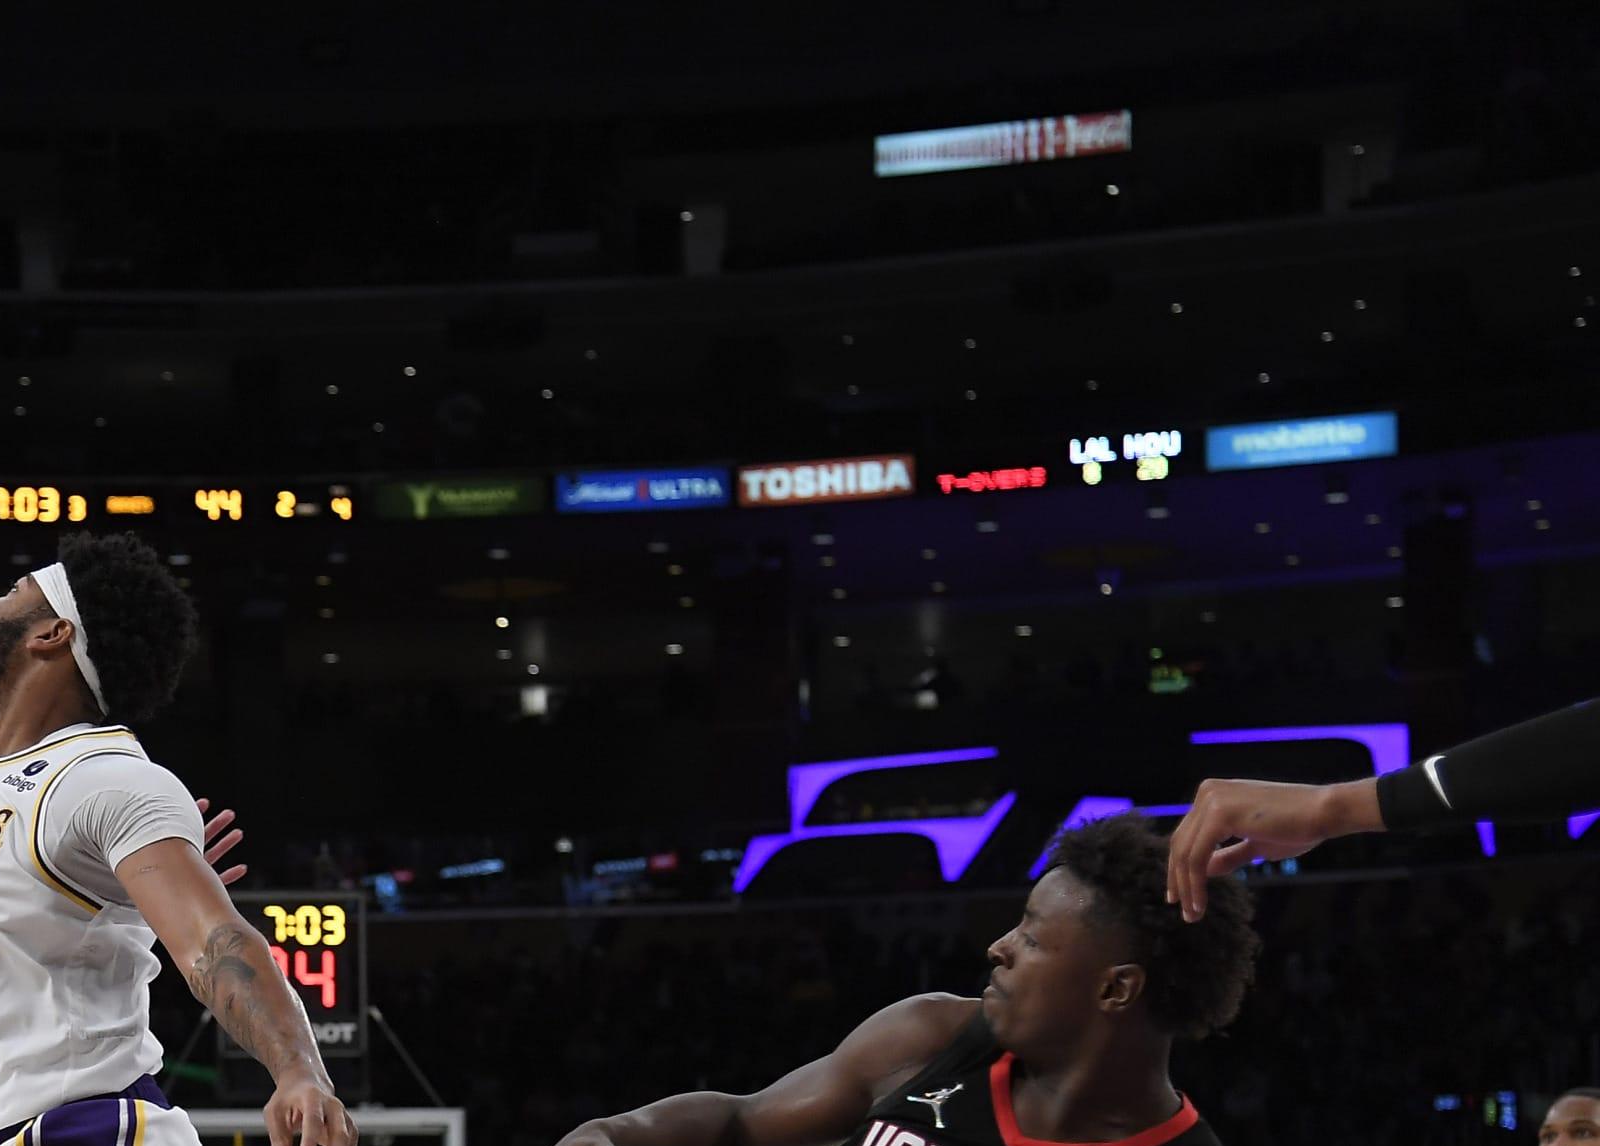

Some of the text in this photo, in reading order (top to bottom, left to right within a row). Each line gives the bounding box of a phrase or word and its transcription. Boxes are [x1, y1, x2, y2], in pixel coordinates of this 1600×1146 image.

[1069, 429, 1182, 464] LAL HOU
[740, 458, 911, 502] TOSHIBA
[195, 489, 243, 521] 44
[2, 774, 36, 793] bibigo
[263, 905, 347, 946] 7:03
